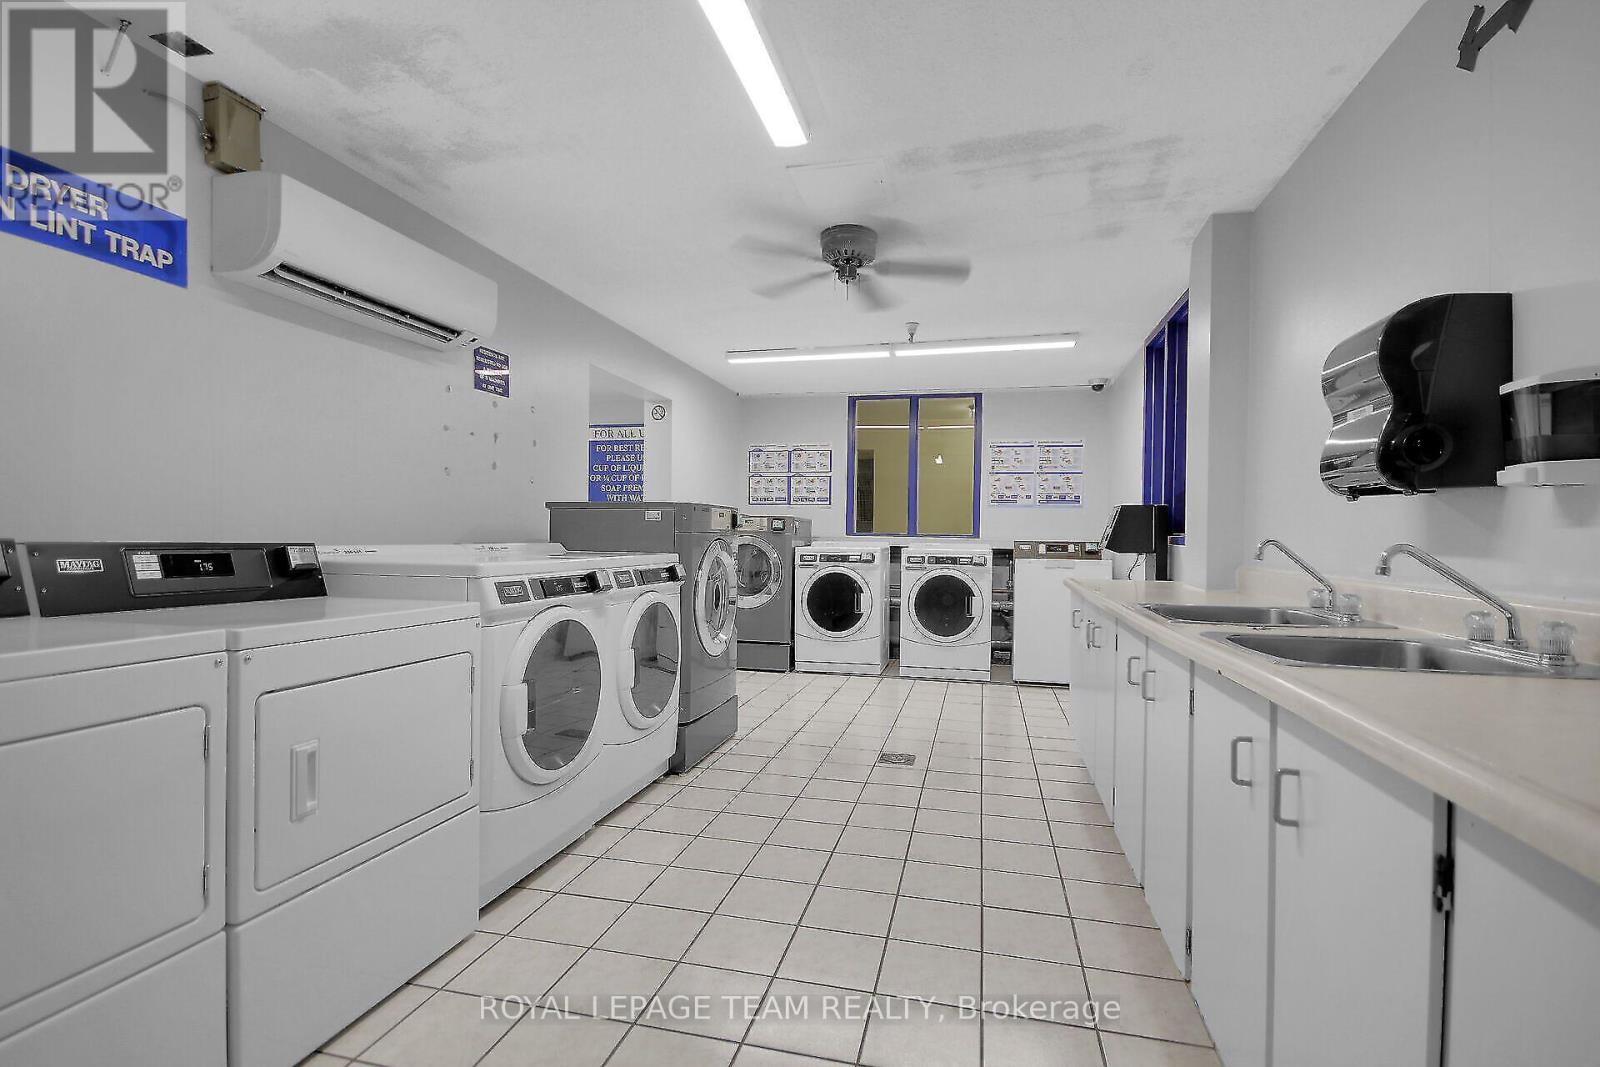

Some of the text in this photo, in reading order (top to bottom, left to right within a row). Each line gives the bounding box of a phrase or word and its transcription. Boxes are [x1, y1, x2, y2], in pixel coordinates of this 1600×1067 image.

[5, 162, 109, 221] DRYER
[30, 203, 97, 245] LINT
[104, 229, 174, 269] TRAP
[594, 429, 614, 439] FOR
[617, 429, 637, 439] ALL
[596, 444, 612, 452] FOR
[613, 444, 634, 452] BEST
[606, 454, 636, 462] PLEASE
[592, 464, 609, 472] CUP
[610, 464, 622, 472] OF
[590, 474, 602, 482] OR
[611, 474, 627, 482] CUP
[628, 474, 640, 482] OF
[601, 484, 622, 492] SOAP
